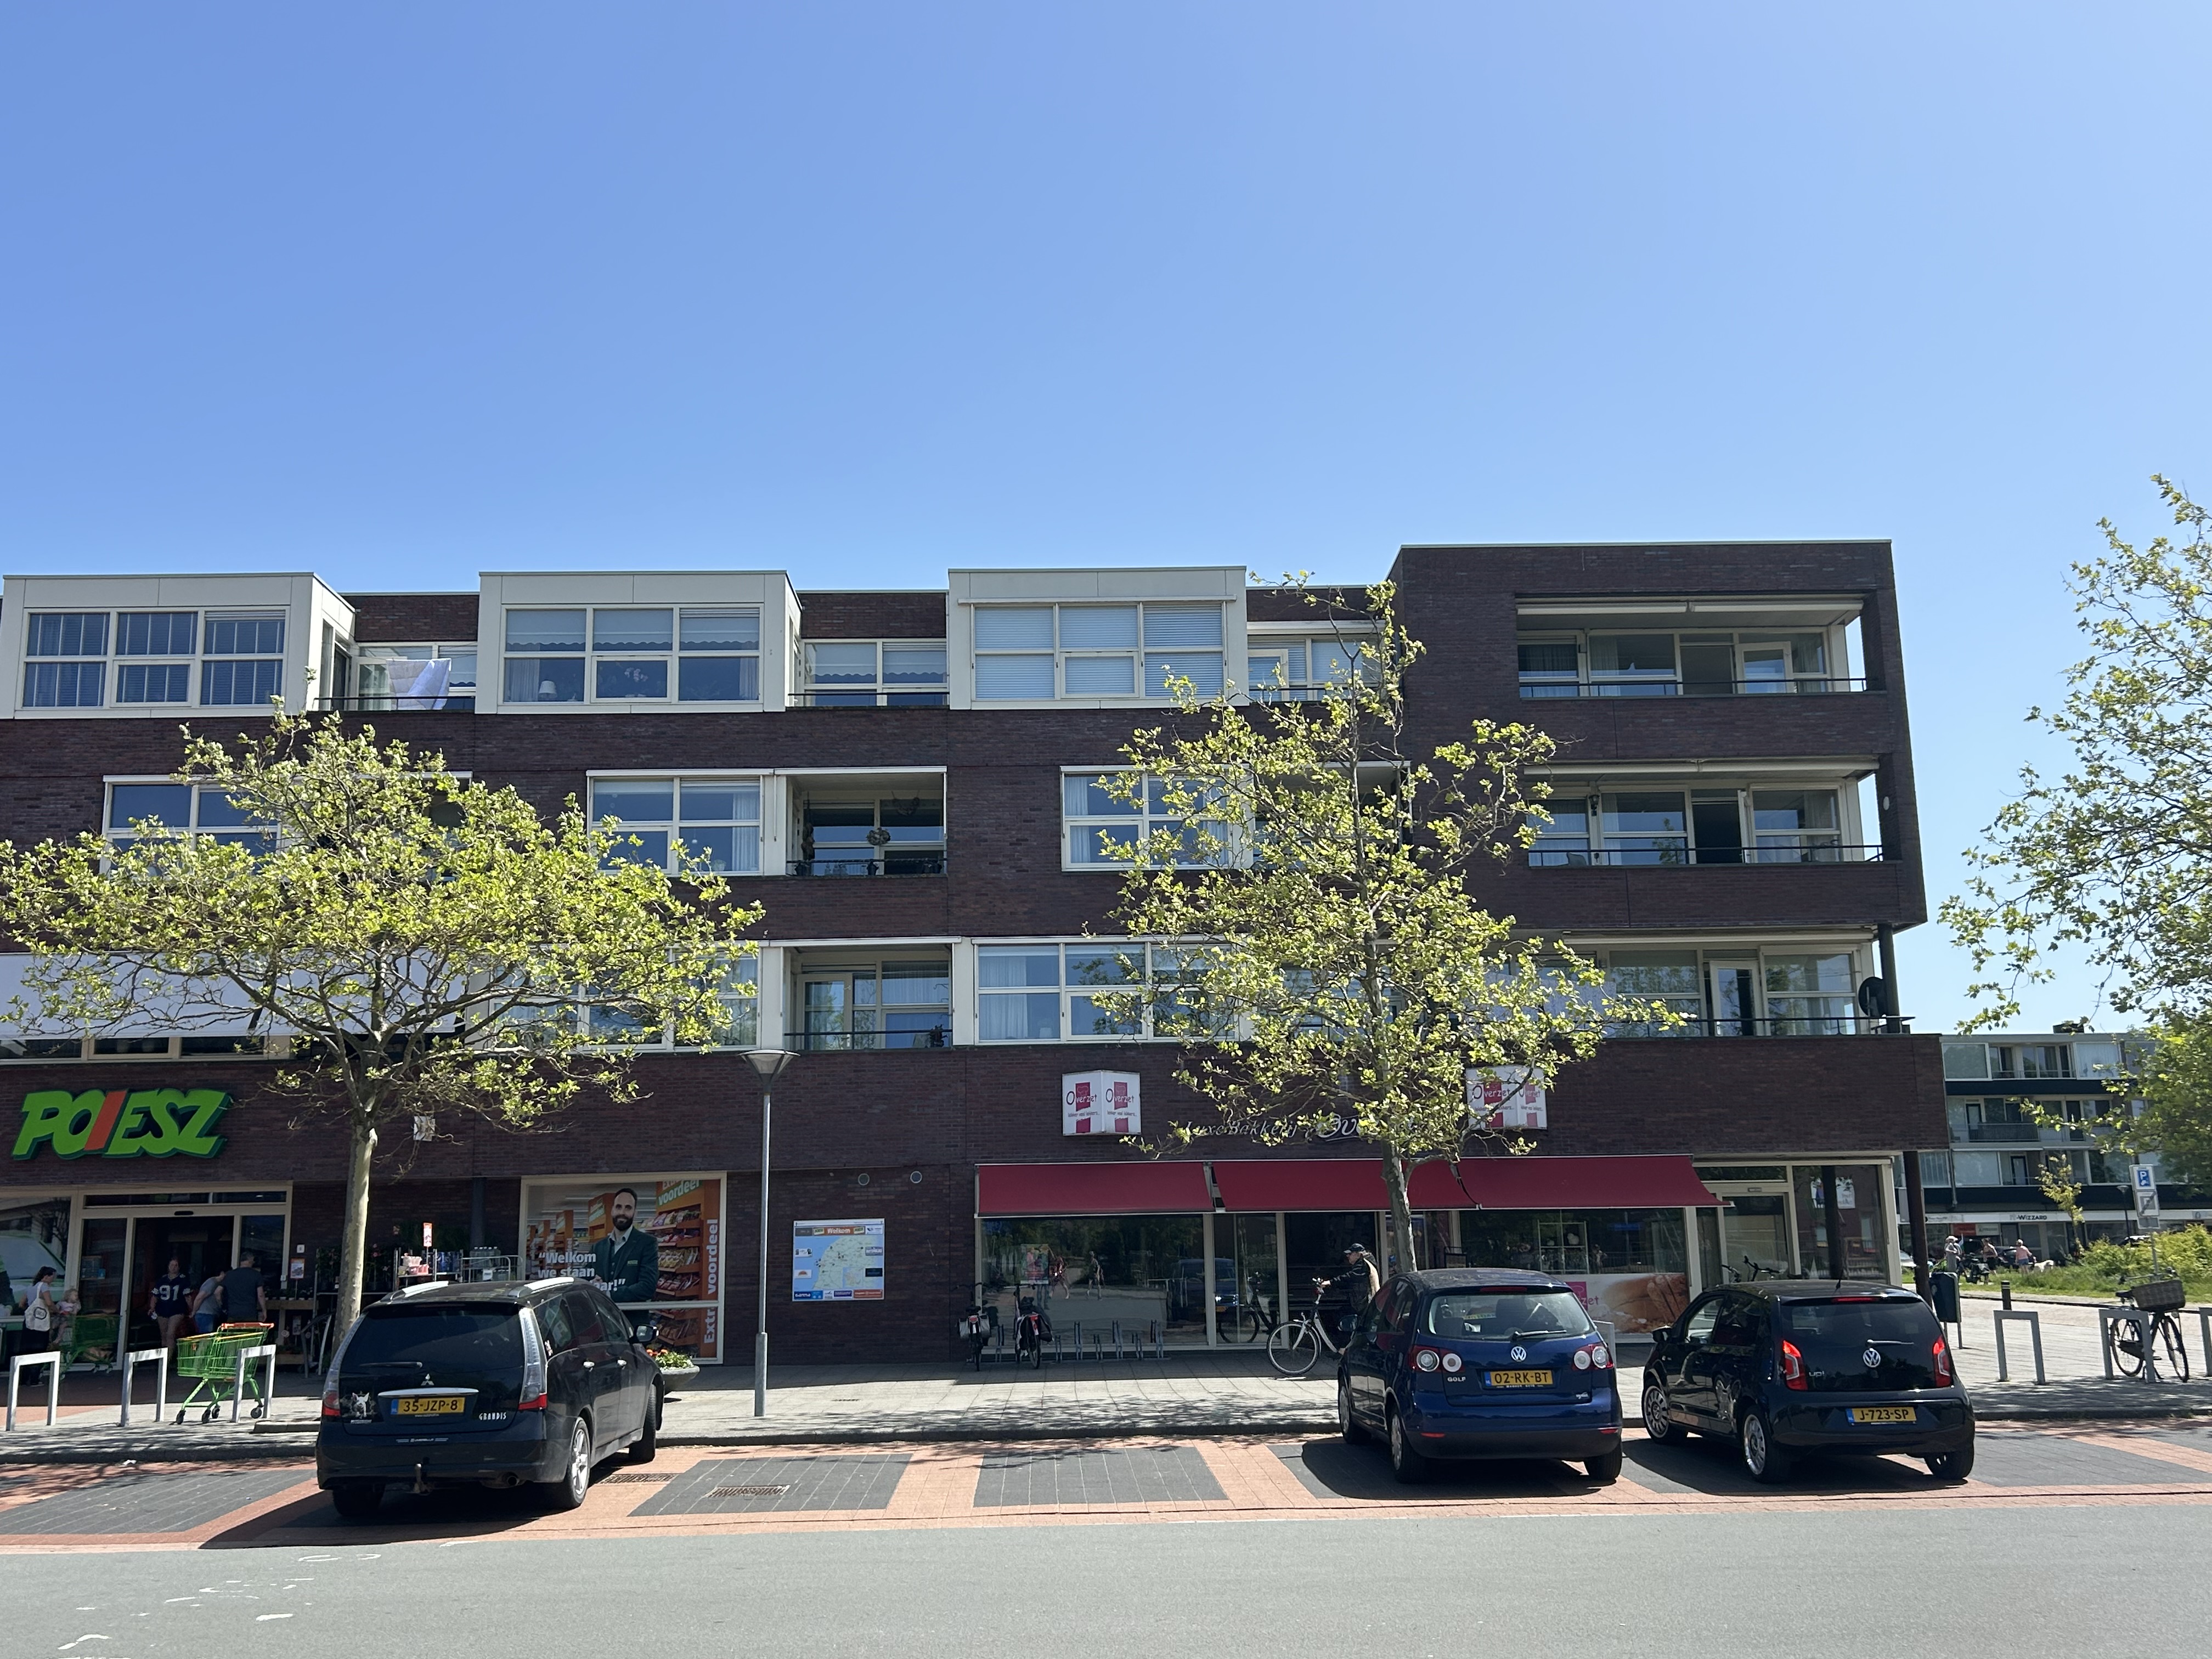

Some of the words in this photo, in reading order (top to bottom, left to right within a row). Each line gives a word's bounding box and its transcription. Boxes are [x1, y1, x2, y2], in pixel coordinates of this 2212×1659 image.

[1066, 1091, 1097, 1105] Overzet
[1105, 1088, 1135, 1103] Overzet
[12, 1088, 230, 1160] POIESZ
[2140, 1171, 2147, 1180] P
[707, 1219, 718, 1295] voordeel
[560, 1267, 595, 1277] staan
[159, 1285, 179, 1301] 91
[703, 1308, 716, 1344] Extr
[1494, 1372, 1548, 1384] 02-RK-BT
[403, 1400, 458, 1412] 35-JZP-8
[478, 1412, 506, 1420] GRANDIS
[1860, 1409, 1909, 1420] J-723-SP
